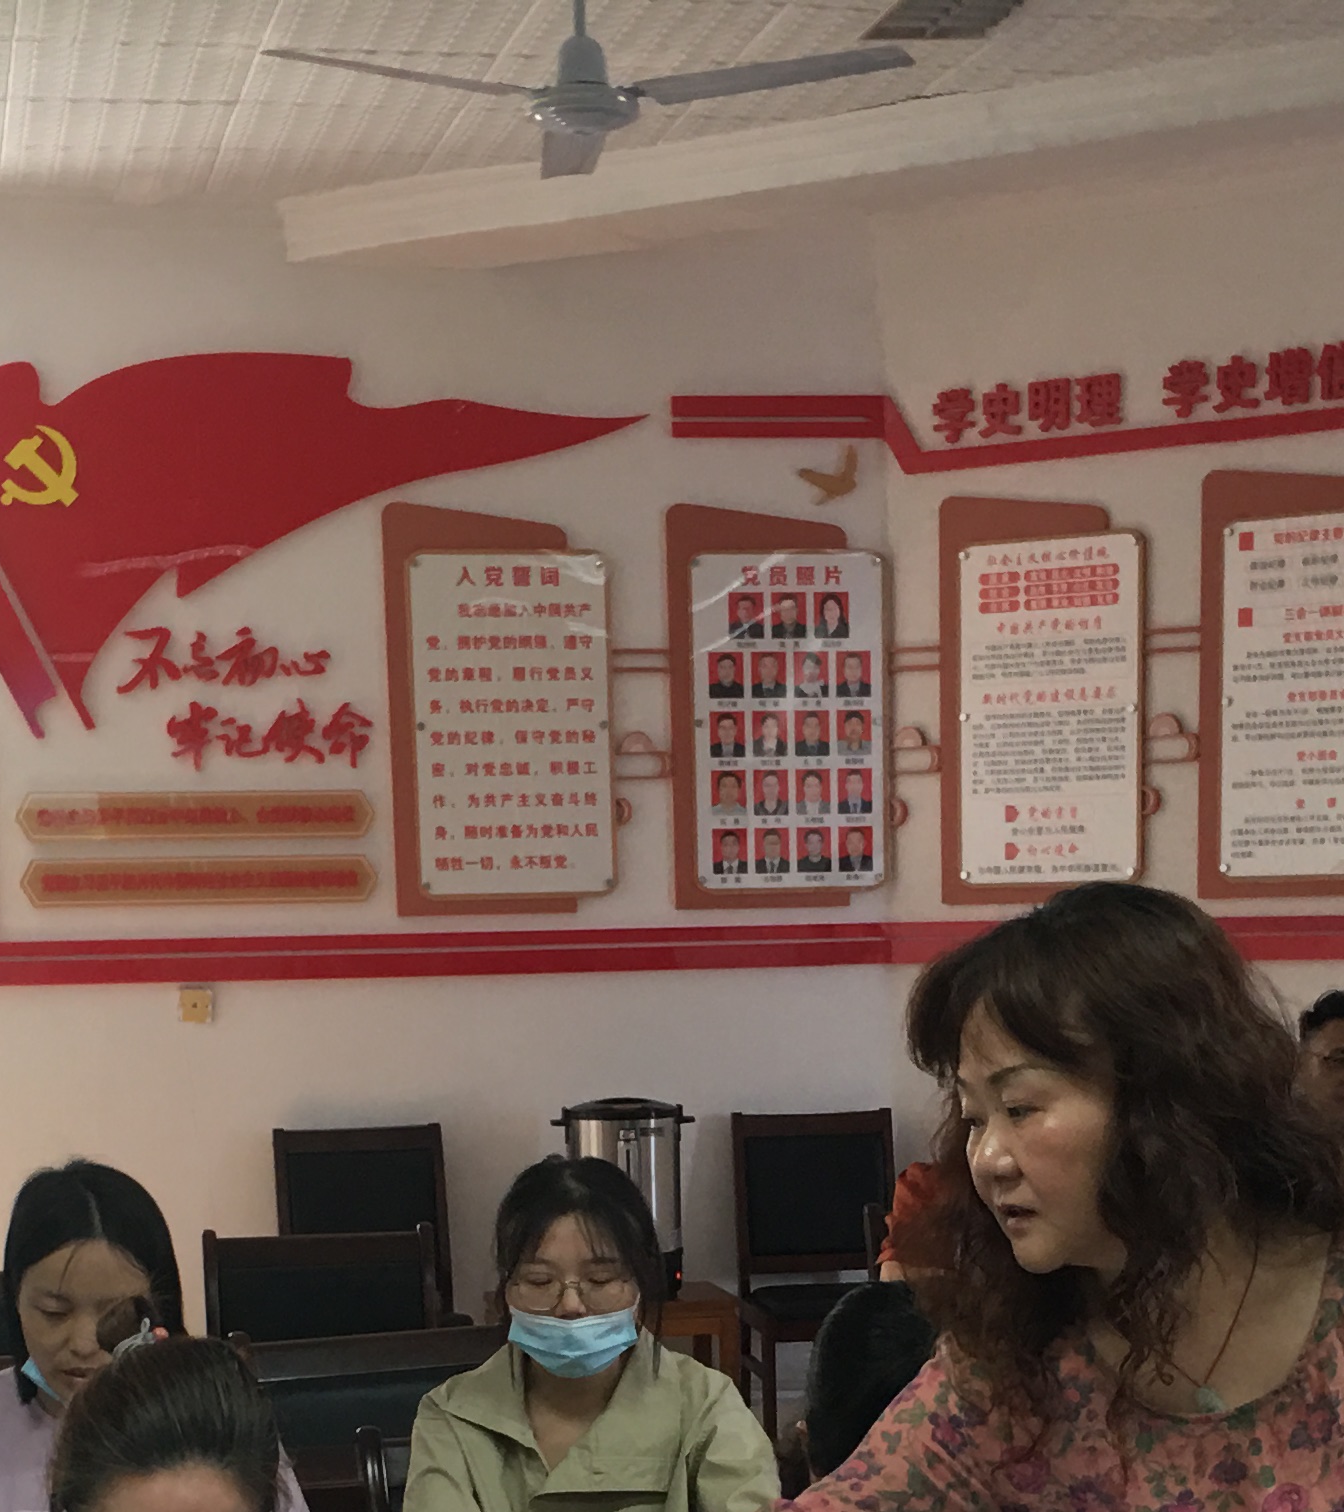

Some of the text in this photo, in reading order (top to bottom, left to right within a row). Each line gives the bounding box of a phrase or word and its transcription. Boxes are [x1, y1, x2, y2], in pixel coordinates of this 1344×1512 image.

[932, 373, 1123, 443] 学史明理
[457, 566, 560, 588] 入党誓词
[740, 565, 843, 587] 党员照片
[116, 626, 331, 694] 不忘初心
[166, 698, 373, 771] 牢记使命
